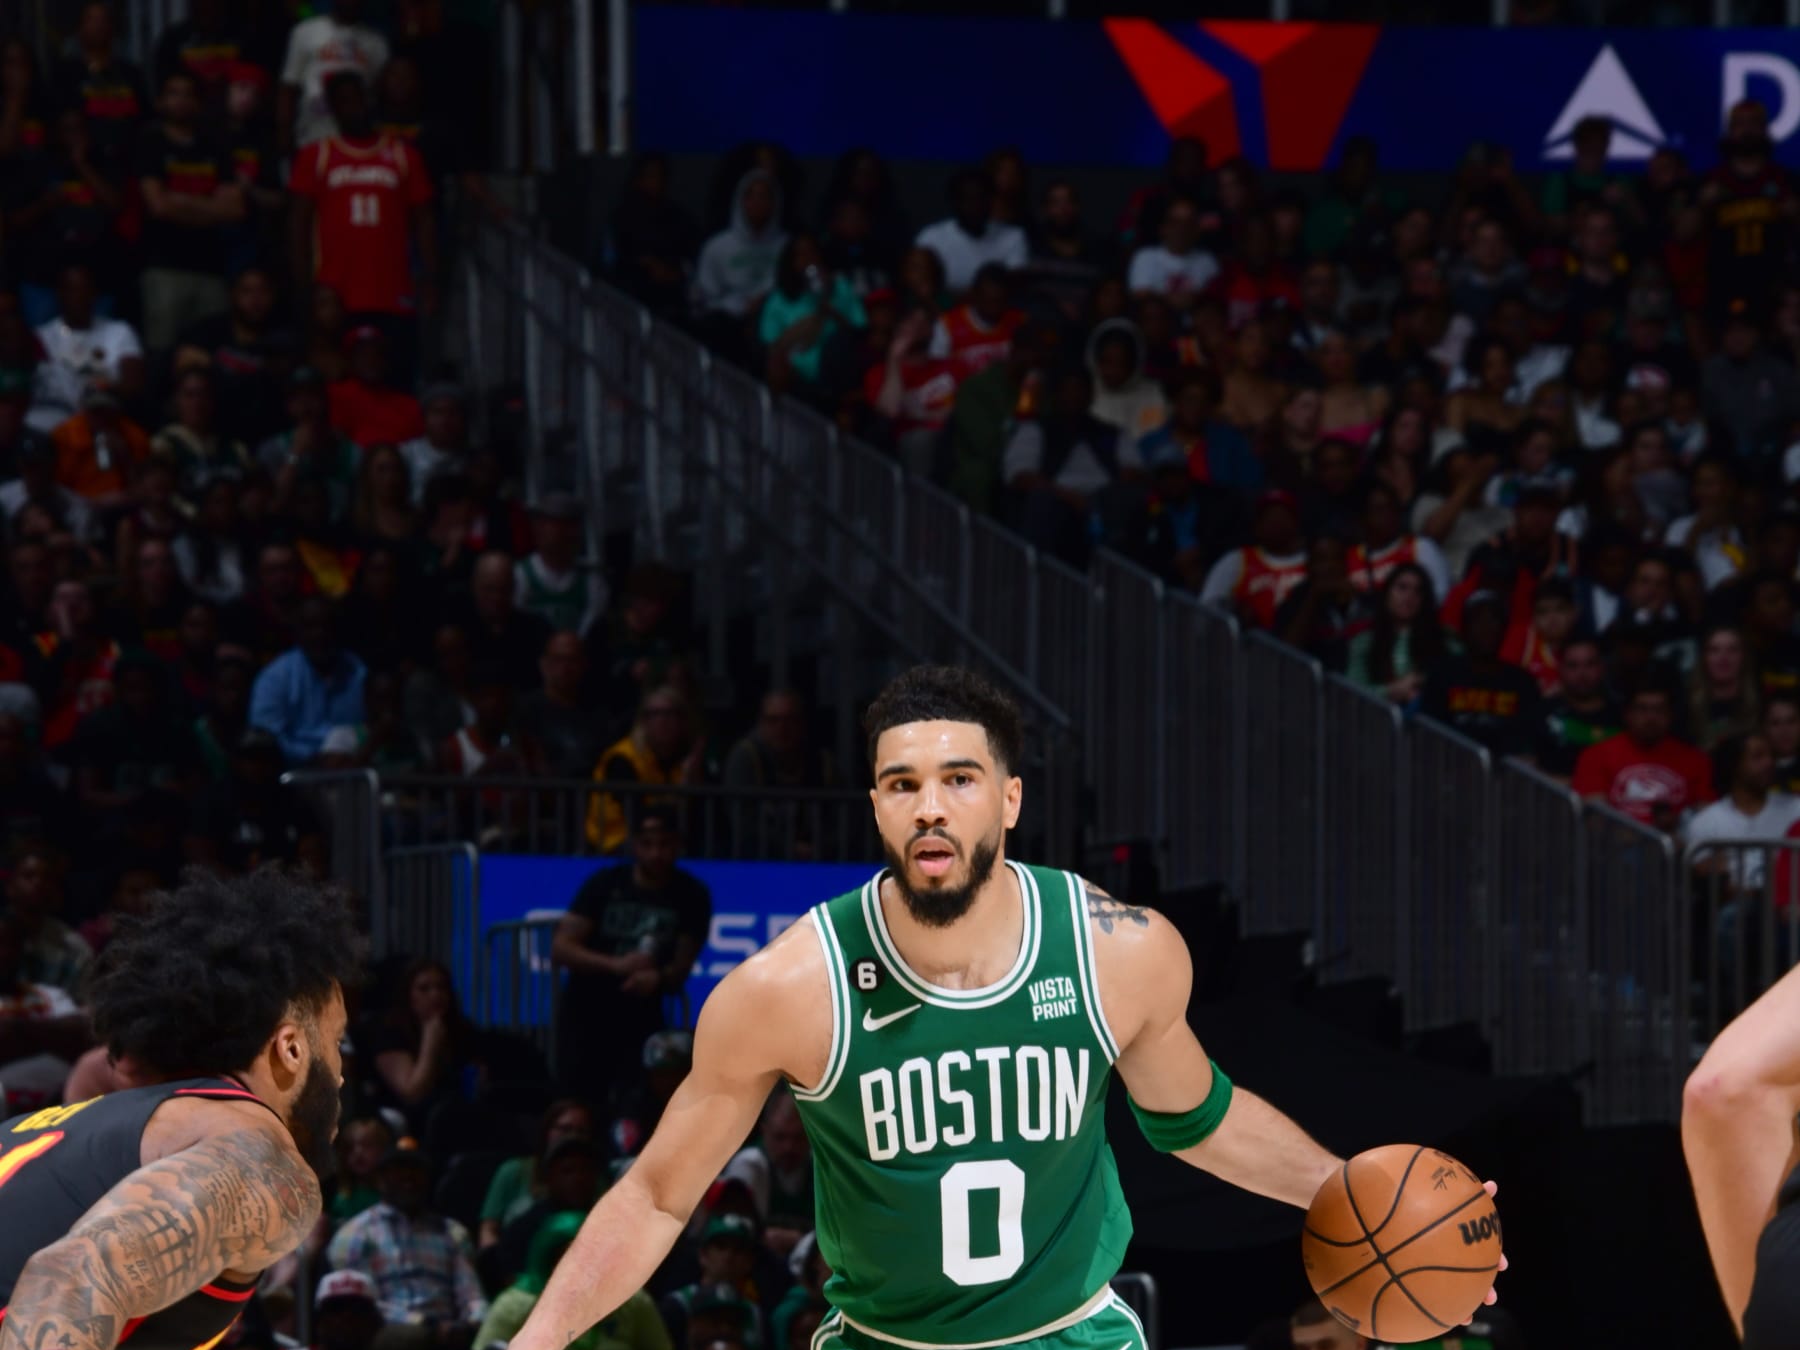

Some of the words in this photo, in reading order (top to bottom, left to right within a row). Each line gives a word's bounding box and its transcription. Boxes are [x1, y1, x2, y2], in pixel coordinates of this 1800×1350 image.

[857, 962, 878, 990] 6
[1029, 976, 1077, 1004] VISTA
[1032, 998, 1078, 1021] PRINT
[859, 1045, 1090, 1161] BOSTON
[940, 1159, 1025, 1286] 0
